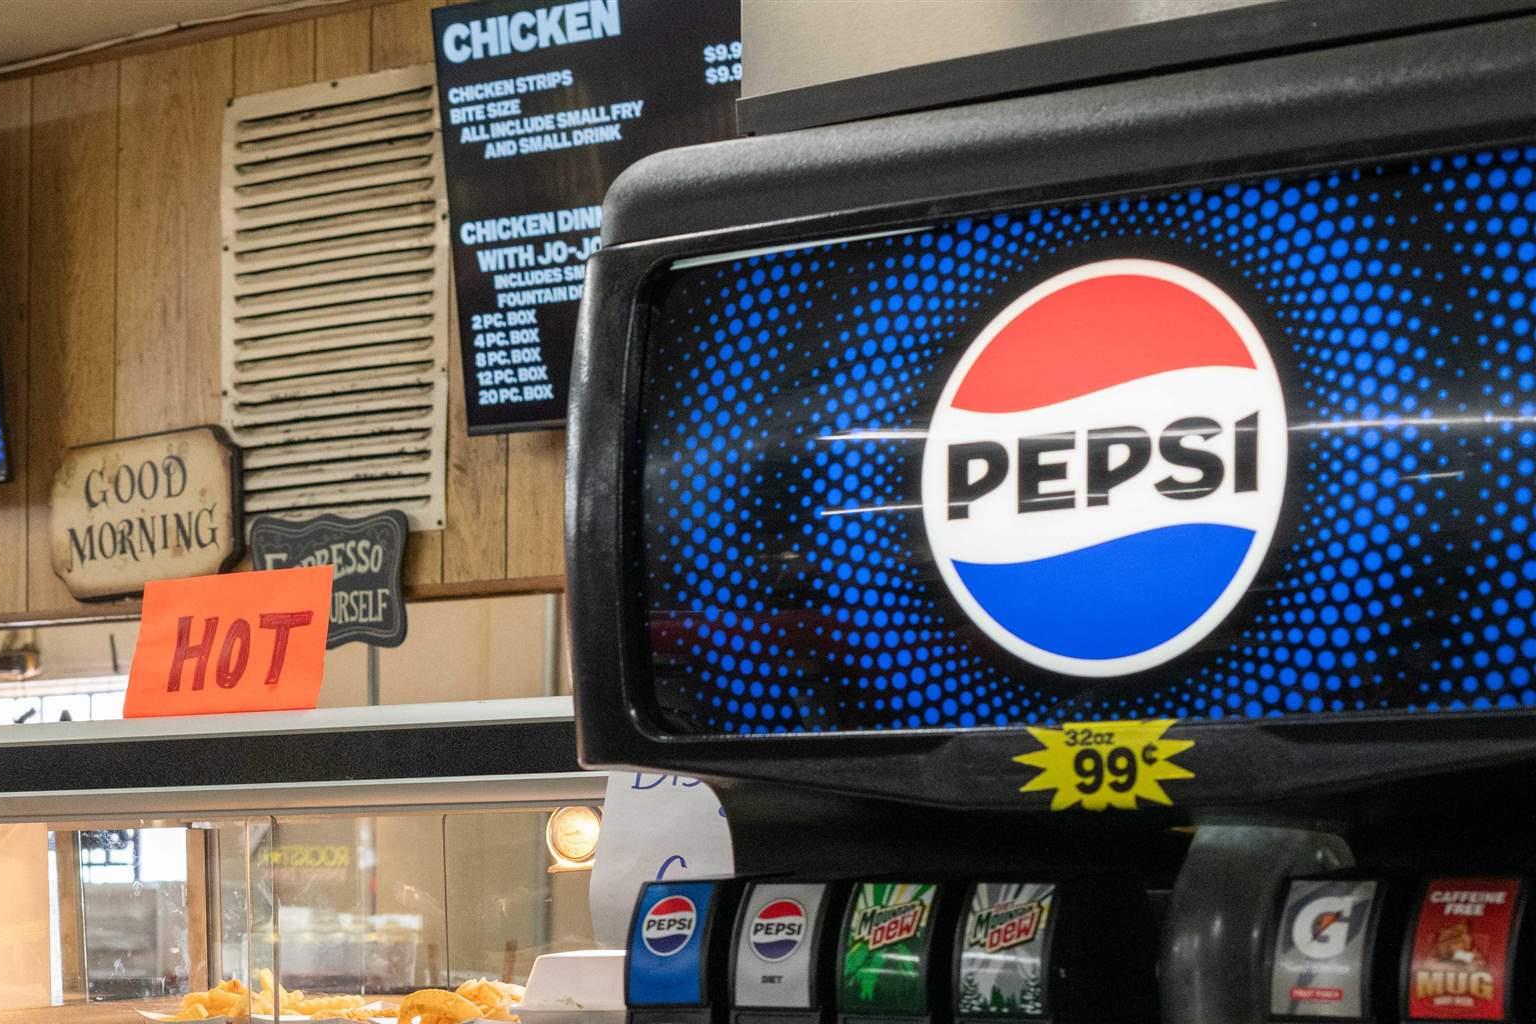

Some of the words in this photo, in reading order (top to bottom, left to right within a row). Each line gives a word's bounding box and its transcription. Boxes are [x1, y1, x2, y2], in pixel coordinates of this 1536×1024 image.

[442, 0, 622, 63] CHICKEN
[704, 41, 743, 63] $9.9
[705, 64, 743, 85] $9.9
[448, 78, 515, 104] CHICKEN
[516, 69, 574, 95] STRIPS
[450, 104, 487, 124] BITE
[487, 100, 522, 120] SIZE
[460, 126, 490, 144] ALL
[491, 114, 556, 139] INCLUDE
[557, 105, 612, 129] SMALL
[613, 100, 644, 121] FRY
[484, 141, 517, 159] AND
[519, 133, 574, 155] SMALL
[574, 124, 623, 147] DRINK
[460, 211, 555, 246] CHICKEN
[477, 245, 534, 272] WITH
[493, 268, 563, 289] INCLUDES
[496, 287, 568, 309] FOUNTAIN
[471, 315, 482, 330] 2
[507, 309, 537, 325] BOX
[473, 333, 485, 348] 4
[510, 328, 540, 344] BOX
[475, 352, 486, 368] 8
[511, 347, 542, 363] BOX
[476, 371, 493, 386] 12
[517, 365, 549, 382] BOX
[478, 389, 498, 405] 20
[523, 384, 554, 400] BOX
[947, 410, 1261, 523] PEPSI
[84, 455, 188, 509] GOOD
[67, 503, 219, 574] MORNING
[167, 610, 314, 693] HOT
[1064, 729, 1115, 747] 32oz
[1430, 891, 1508, 905] CAFFEINE
[1444, 903, 1486, 917] FREE
[645, 916, 692, 932] PEPSI
[753, 922, 802, 937] PEPSI
[1292, 895, 1356, 959] G
[760, 975, 783, 985] DIET
[1415, 970, 1495, 999] MUG
